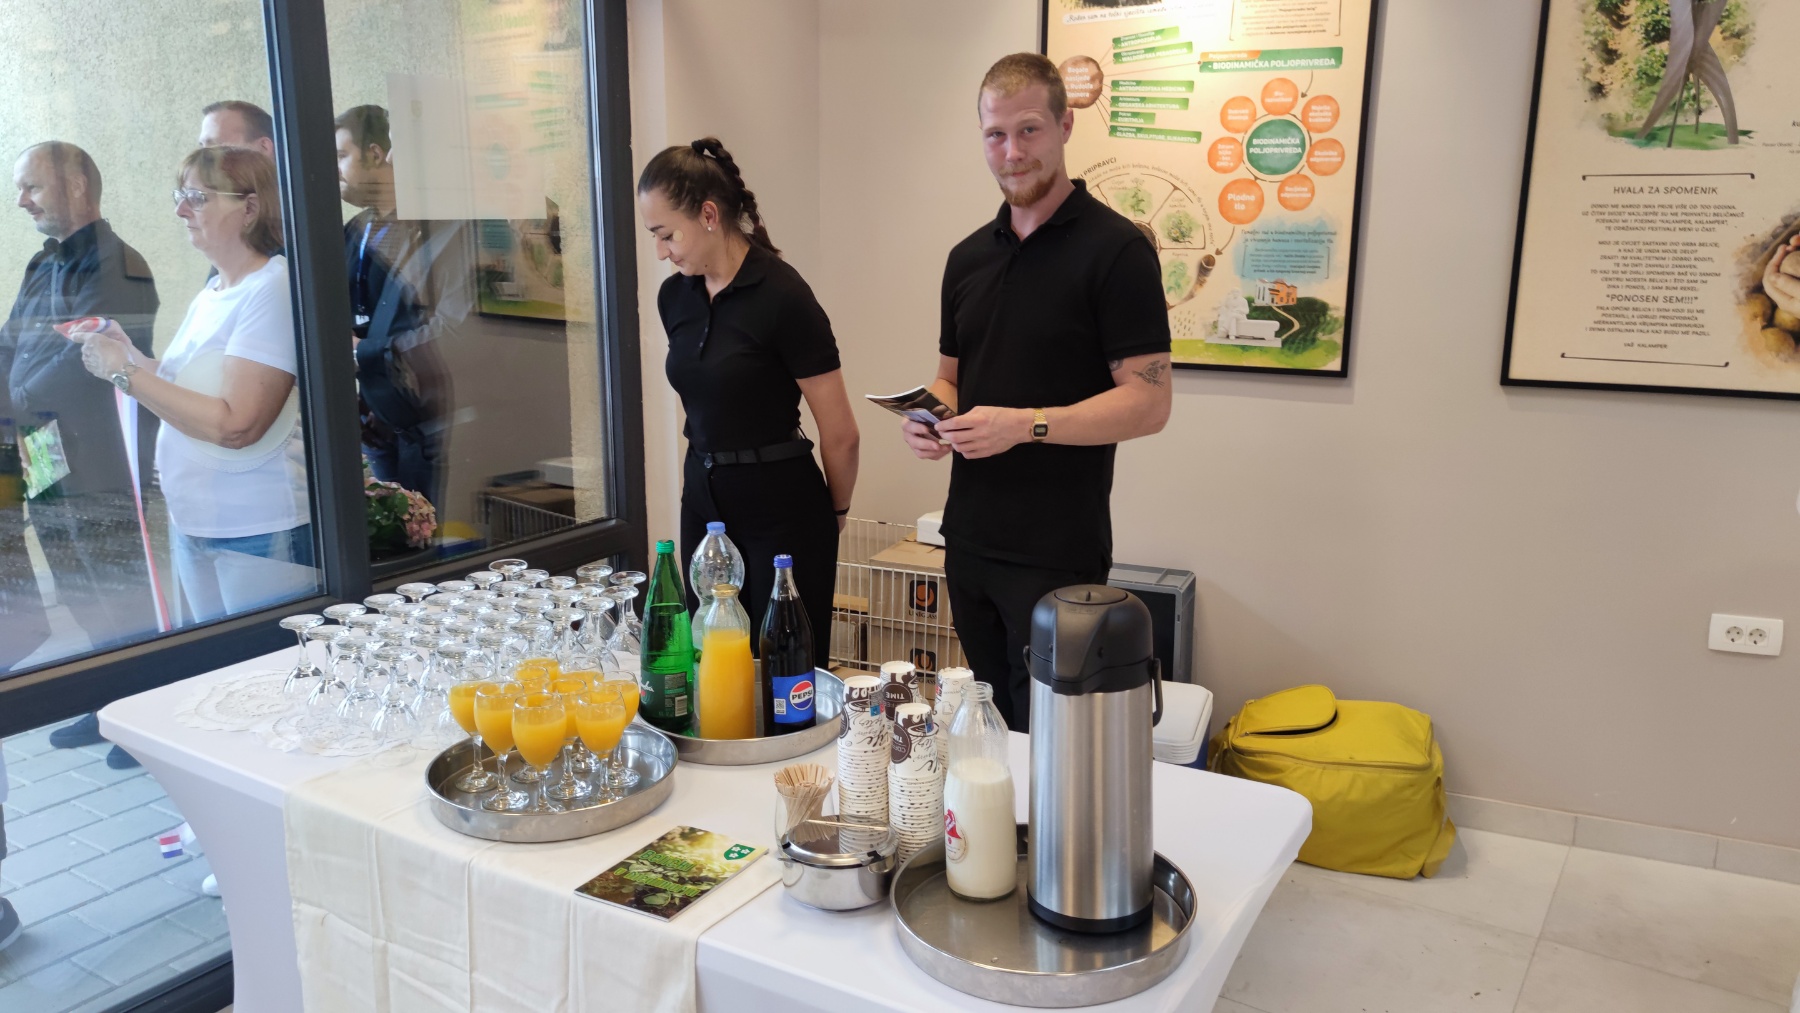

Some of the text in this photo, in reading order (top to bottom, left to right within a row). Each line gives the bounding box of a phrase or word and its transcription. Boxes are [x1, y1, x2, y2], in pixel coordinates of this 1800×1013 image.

[1213, 58, 1336, 70] BIODINAMIČKA POLJOPRIVREDA
[1252, 137, 1300, 145] BIODINAMIČKA
[1084, 157, 1117, 176] PRIPRAVCI
[1664, 186, 1718, 194] SPOMENIK
[792, 690, 812, 700] PEPSI
